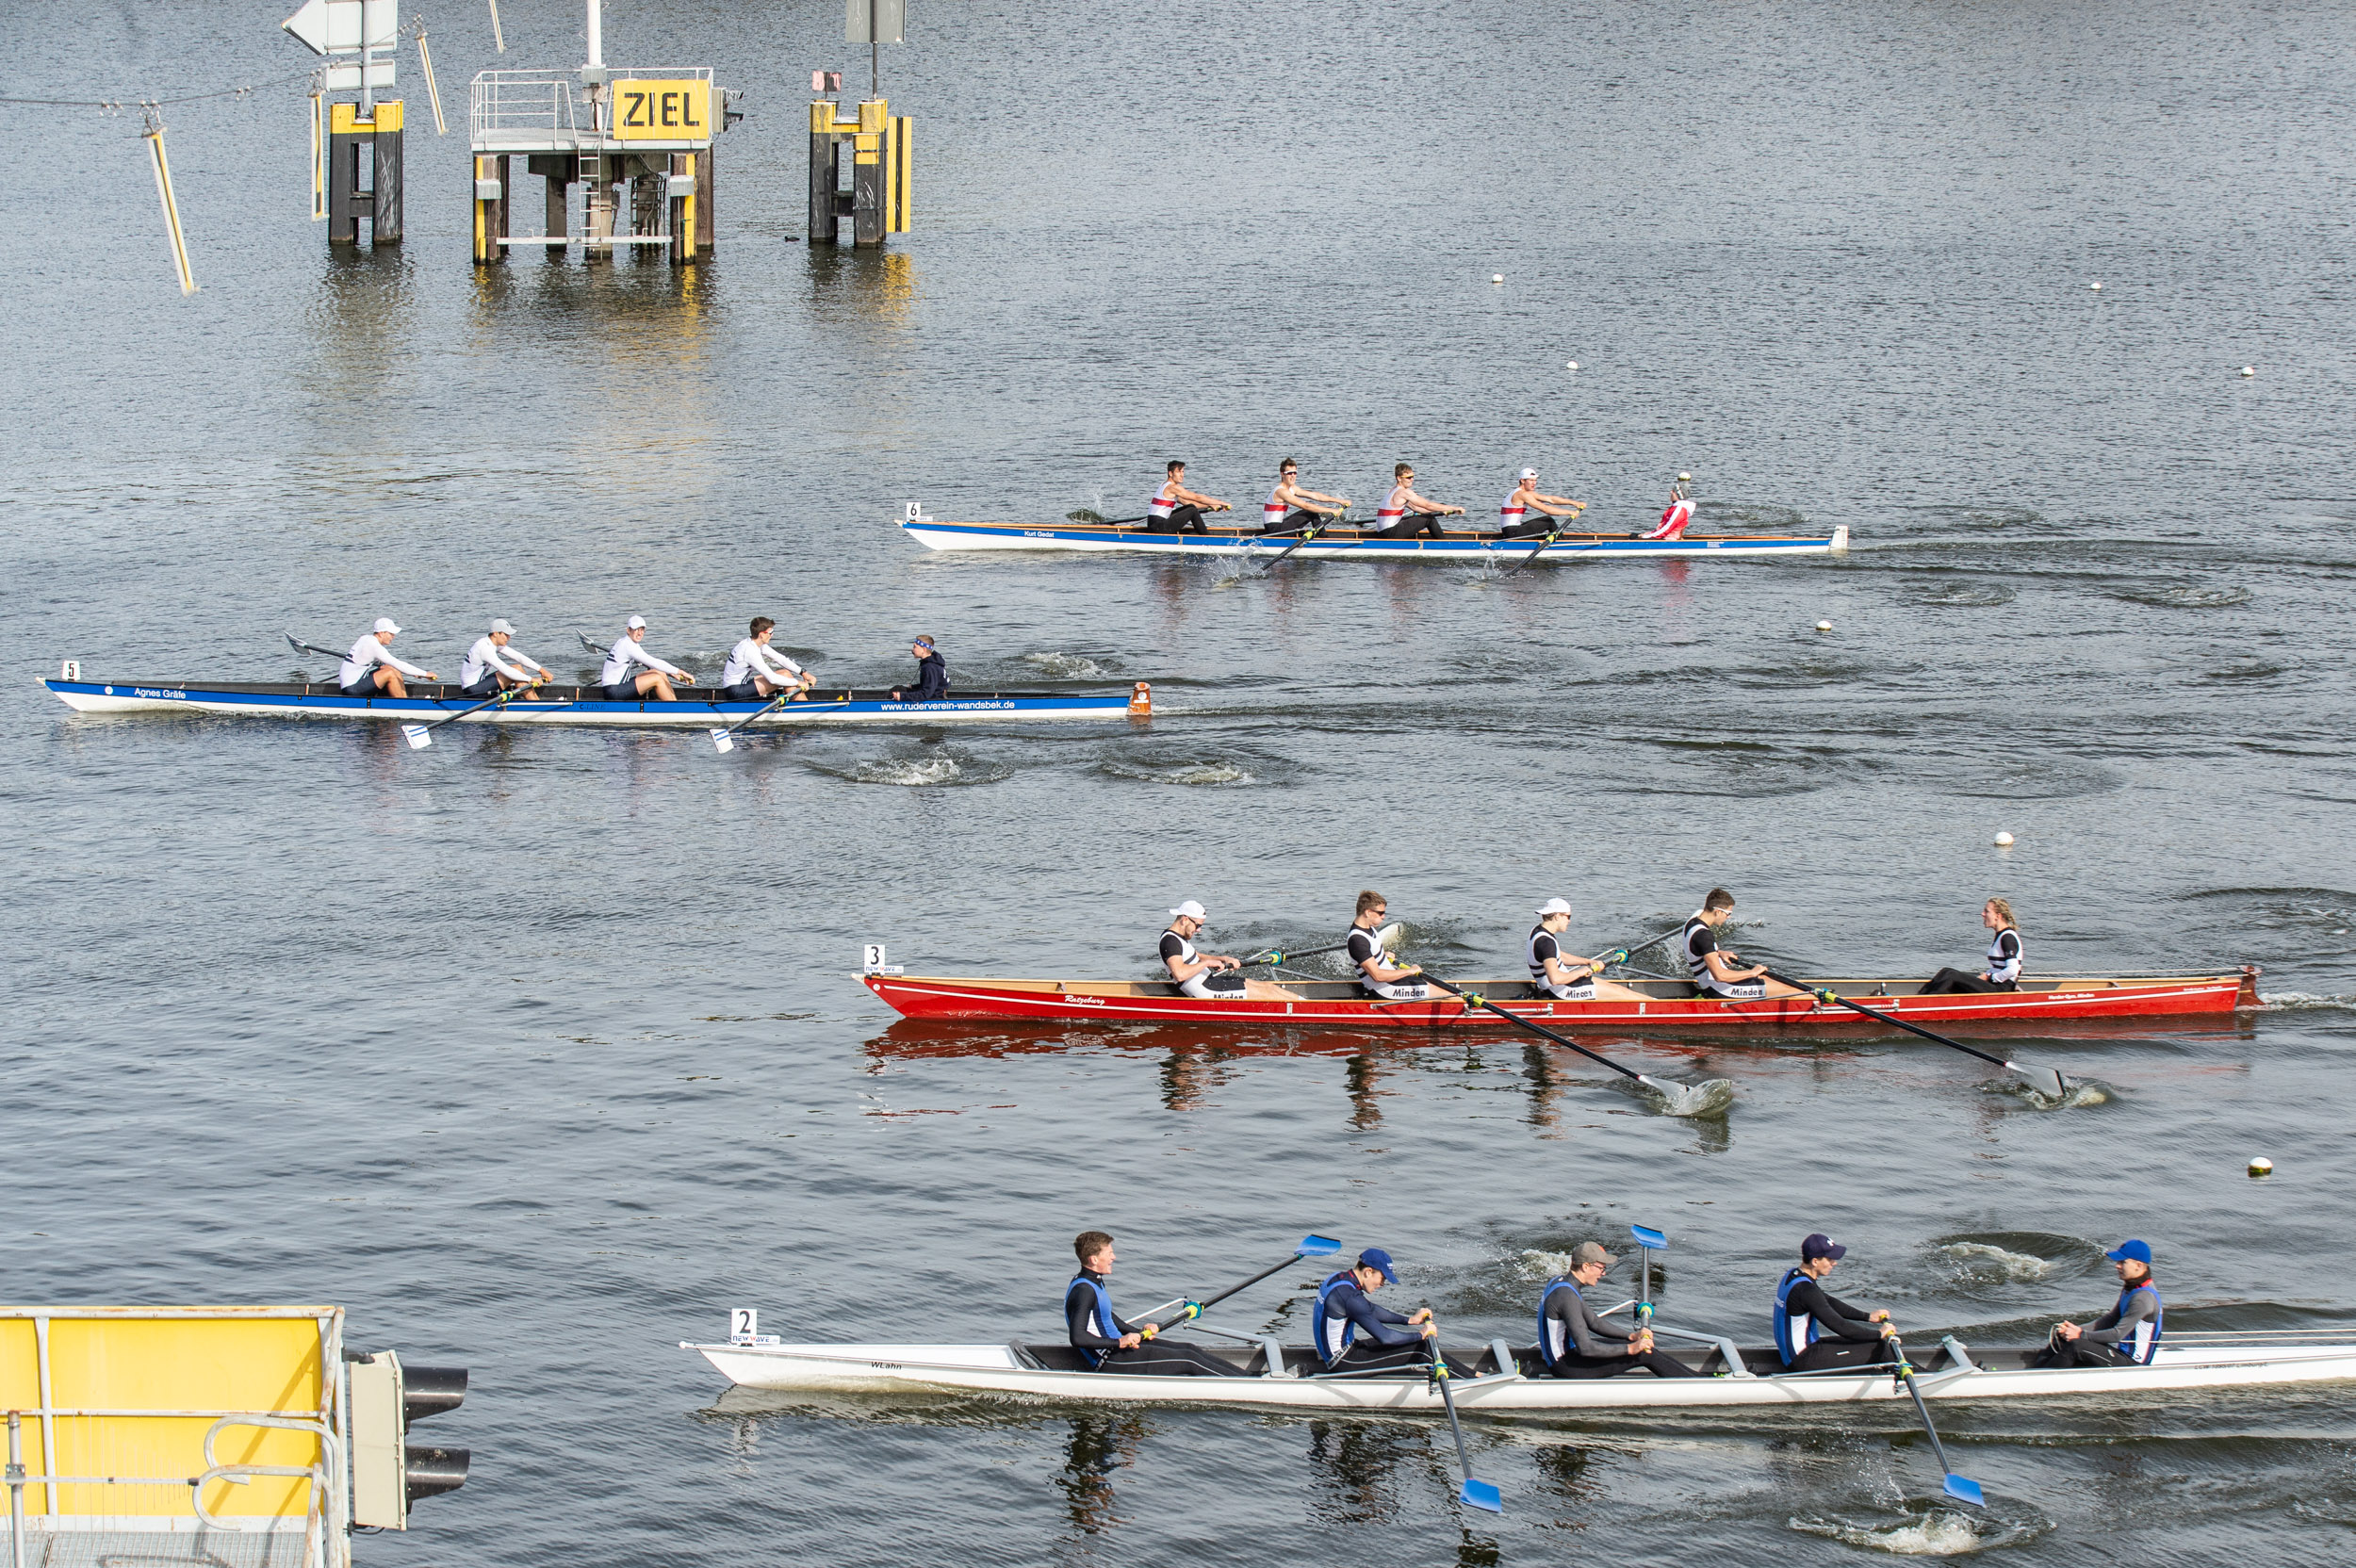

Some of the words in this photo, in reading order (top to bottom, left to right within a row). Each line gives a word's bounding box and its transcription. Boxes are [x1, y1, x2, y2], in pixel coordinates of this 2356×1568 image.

[623, 92, 699, 126] ZIEL
[910, 503, 918, 516] 6
[69, 662, 74, 678] 5
[135, 687, 161, 699] Agnes
[163, 689, 187, 699] Gräfe
[881, 700, 1015, 711] www.ruderverein-wandsbek.de
[870, 946, 879, 965] 3
[1393, 988, 1426, 998] Minden
[1730, 987, 1763, 997] Minden
[1065, 995, 1105, 1006] Ratzeburg
[739, 1310, 751, 1333] 2
[871, 1361, 902, 1370] WLahn
